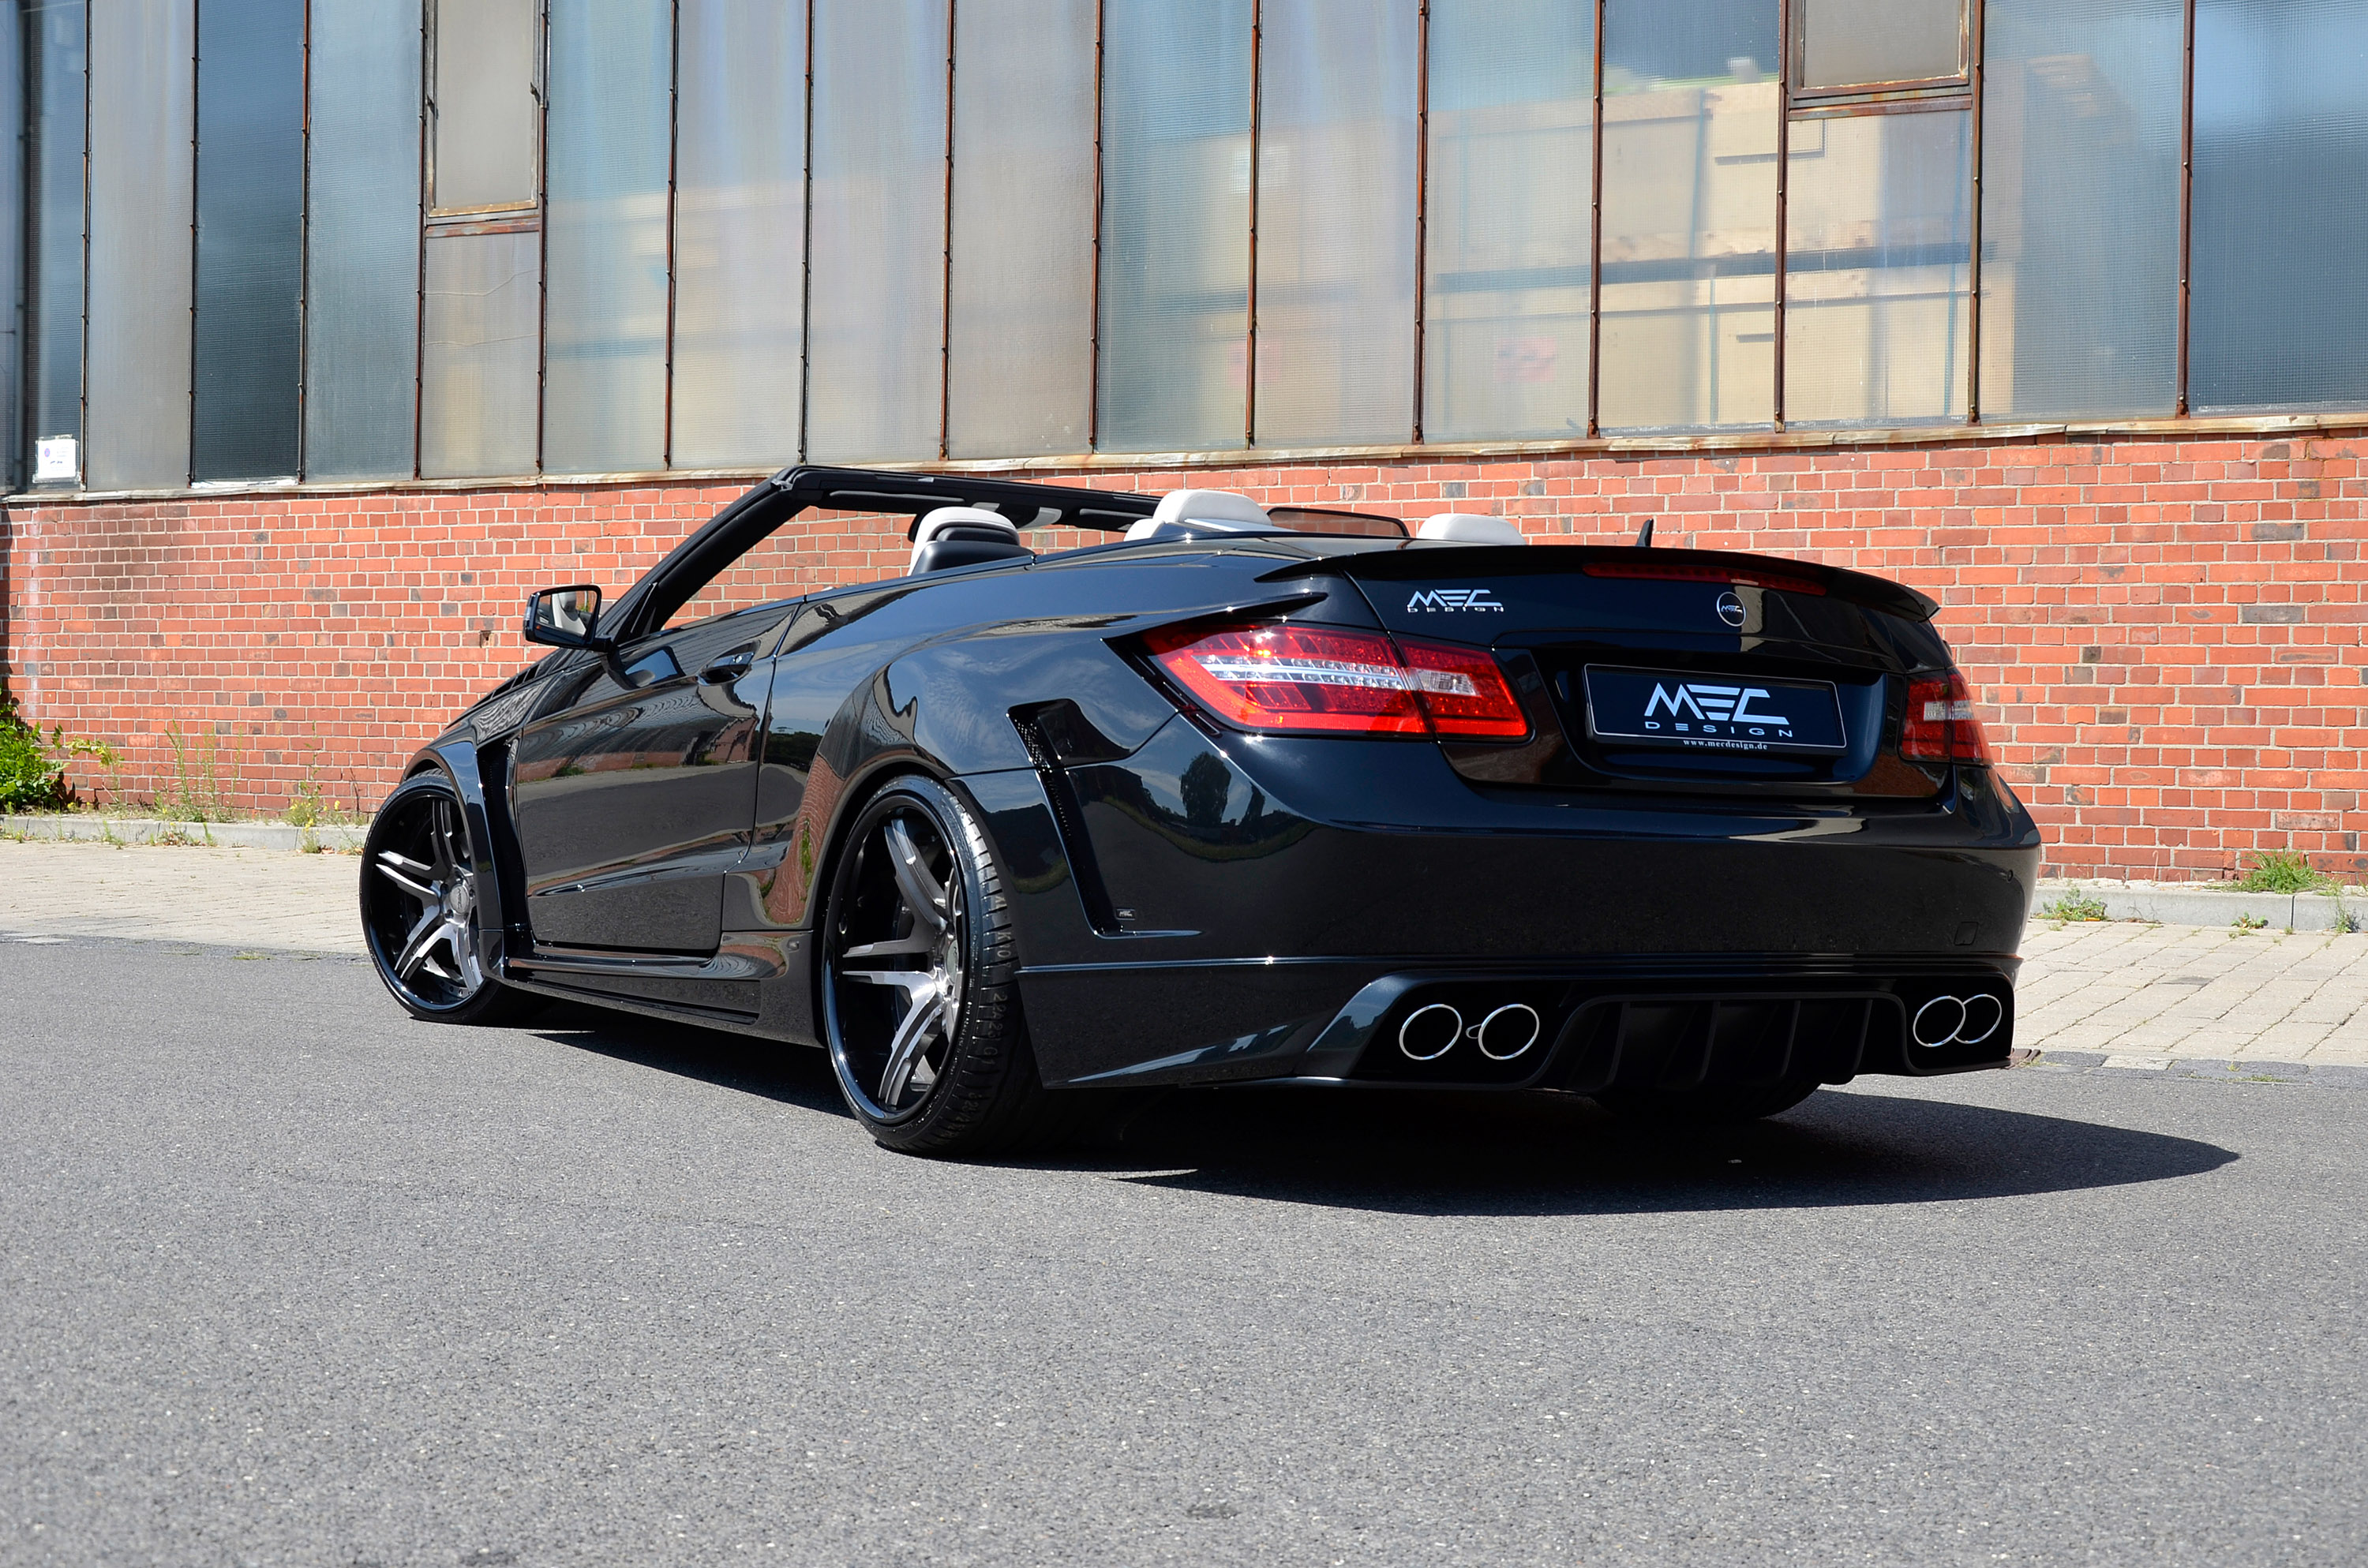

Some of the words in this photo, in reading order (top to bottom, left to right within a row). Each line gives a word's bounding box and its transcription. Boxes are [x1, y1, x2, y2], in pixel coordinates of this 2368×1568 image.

[1407, 589, 1503, 607] MEC
[1644, 683, 1789, 725] MEC
[1645, 721, 1793, 738] DESIGN
[1683, 740, 1768, 750] www.mecdesign.de
